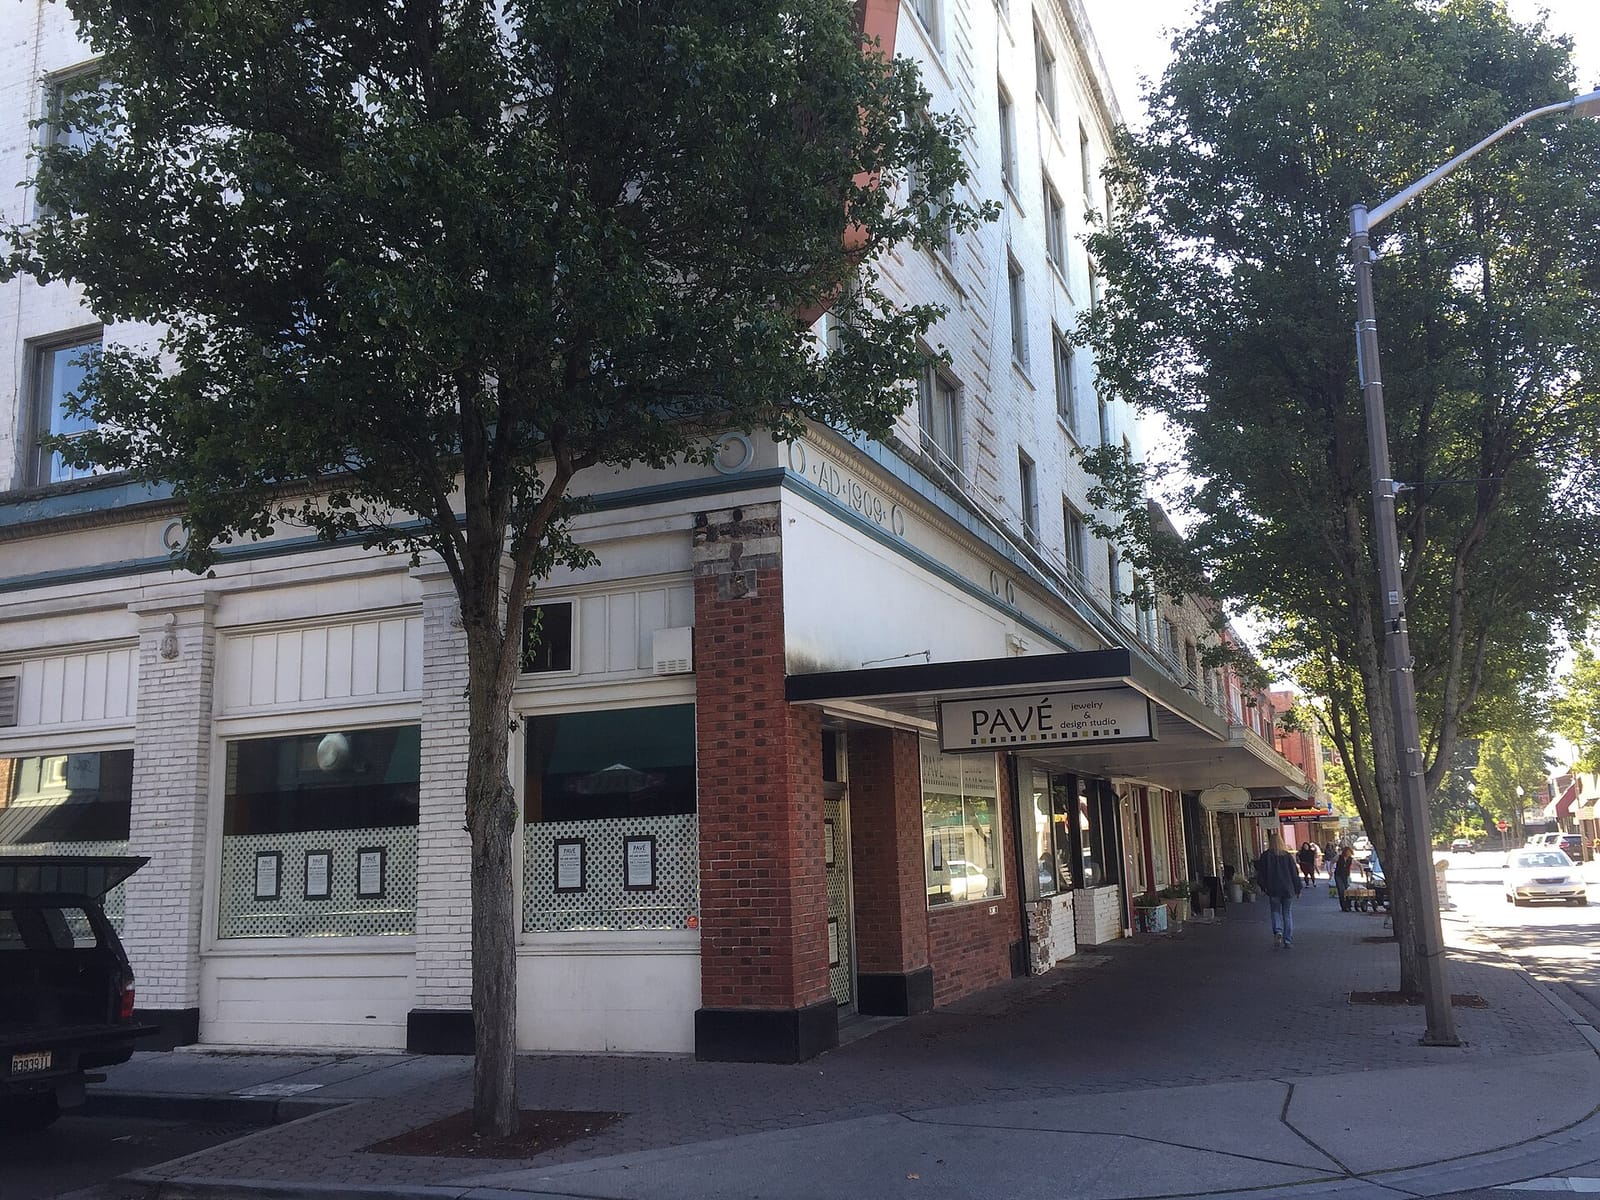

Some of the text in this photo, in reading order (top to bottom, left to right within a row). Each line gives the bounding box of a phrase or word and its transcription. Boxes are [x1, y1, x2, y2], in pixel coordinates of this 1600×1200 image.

[1070, 700, 1103, 712] jewelry
[972, 697, 1053, 736] PAVÉ
[1083, 711, 1091, 719] &
[1060, 717, 1117, 730] design studio
